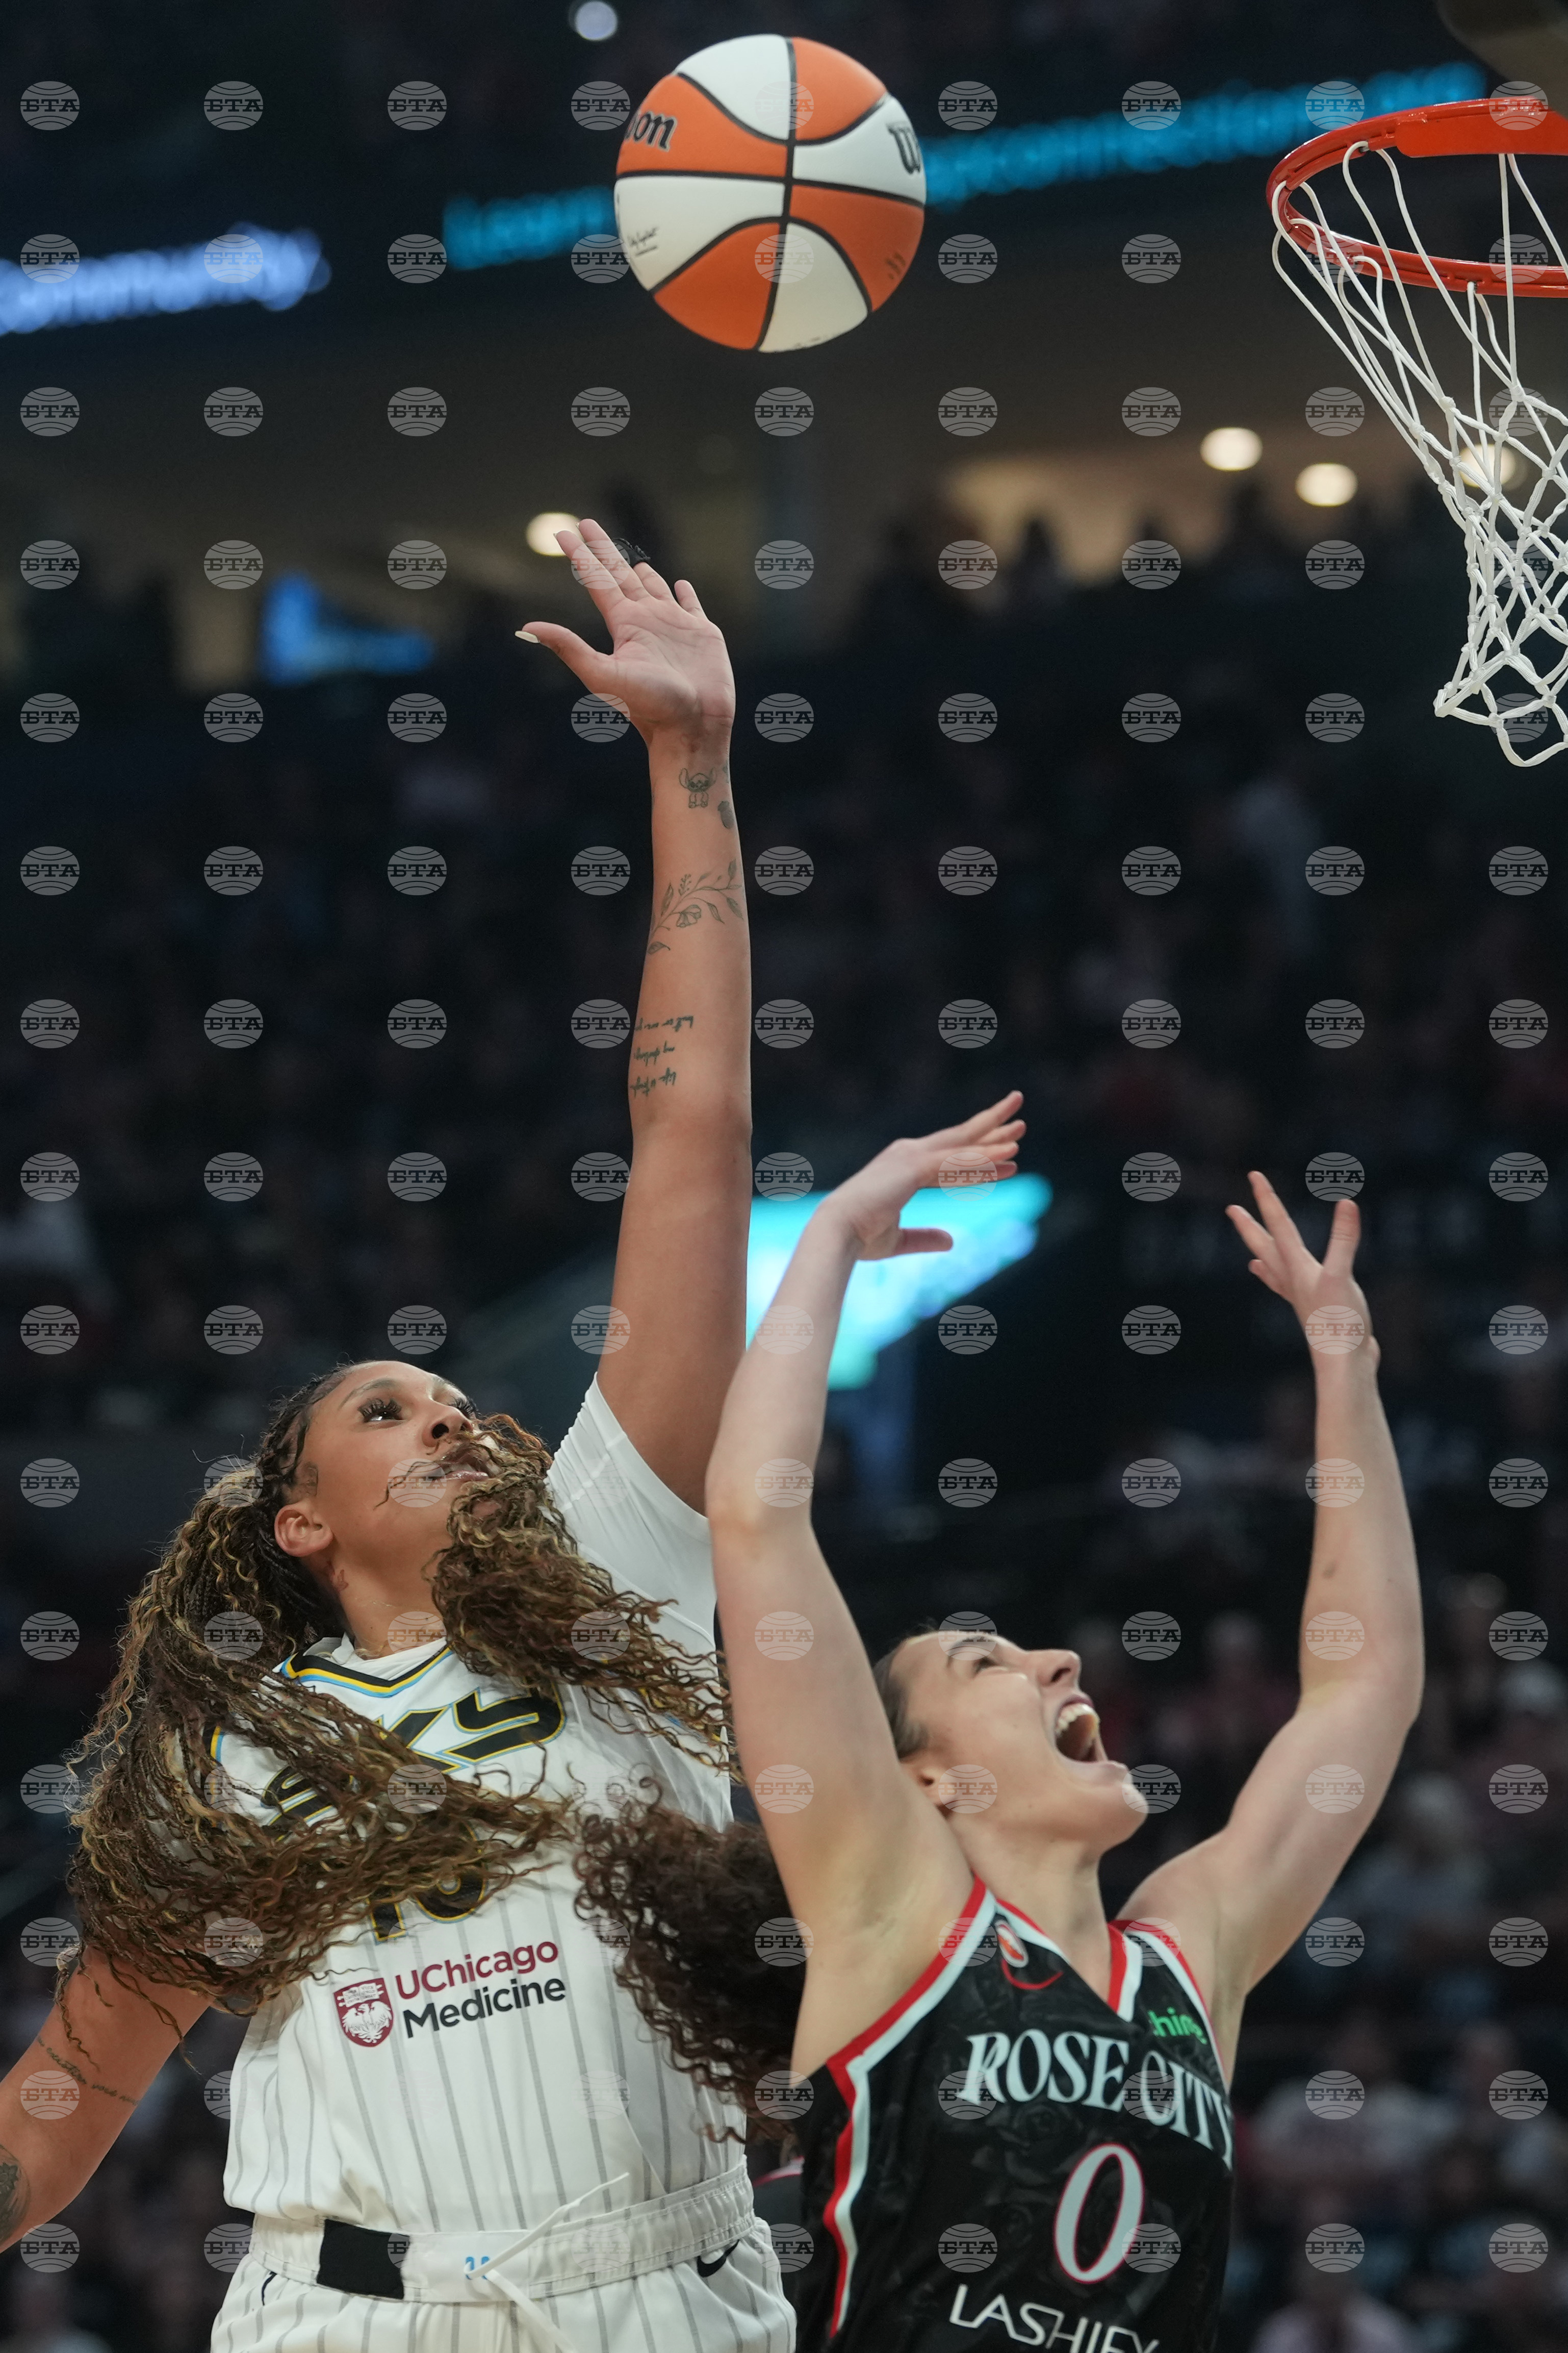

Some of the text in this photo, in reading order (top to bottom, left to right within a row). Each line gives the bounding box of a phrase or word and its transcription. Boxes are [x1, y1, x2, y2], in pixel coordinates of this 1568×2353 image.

[395, 1941, 558, 1999] UChicago
[403, 1978, 565, 2039] Medicine
[955, 2029, 1233, 2171] ROSE CITY
[1052, 2142, 1145, 2284] 0
